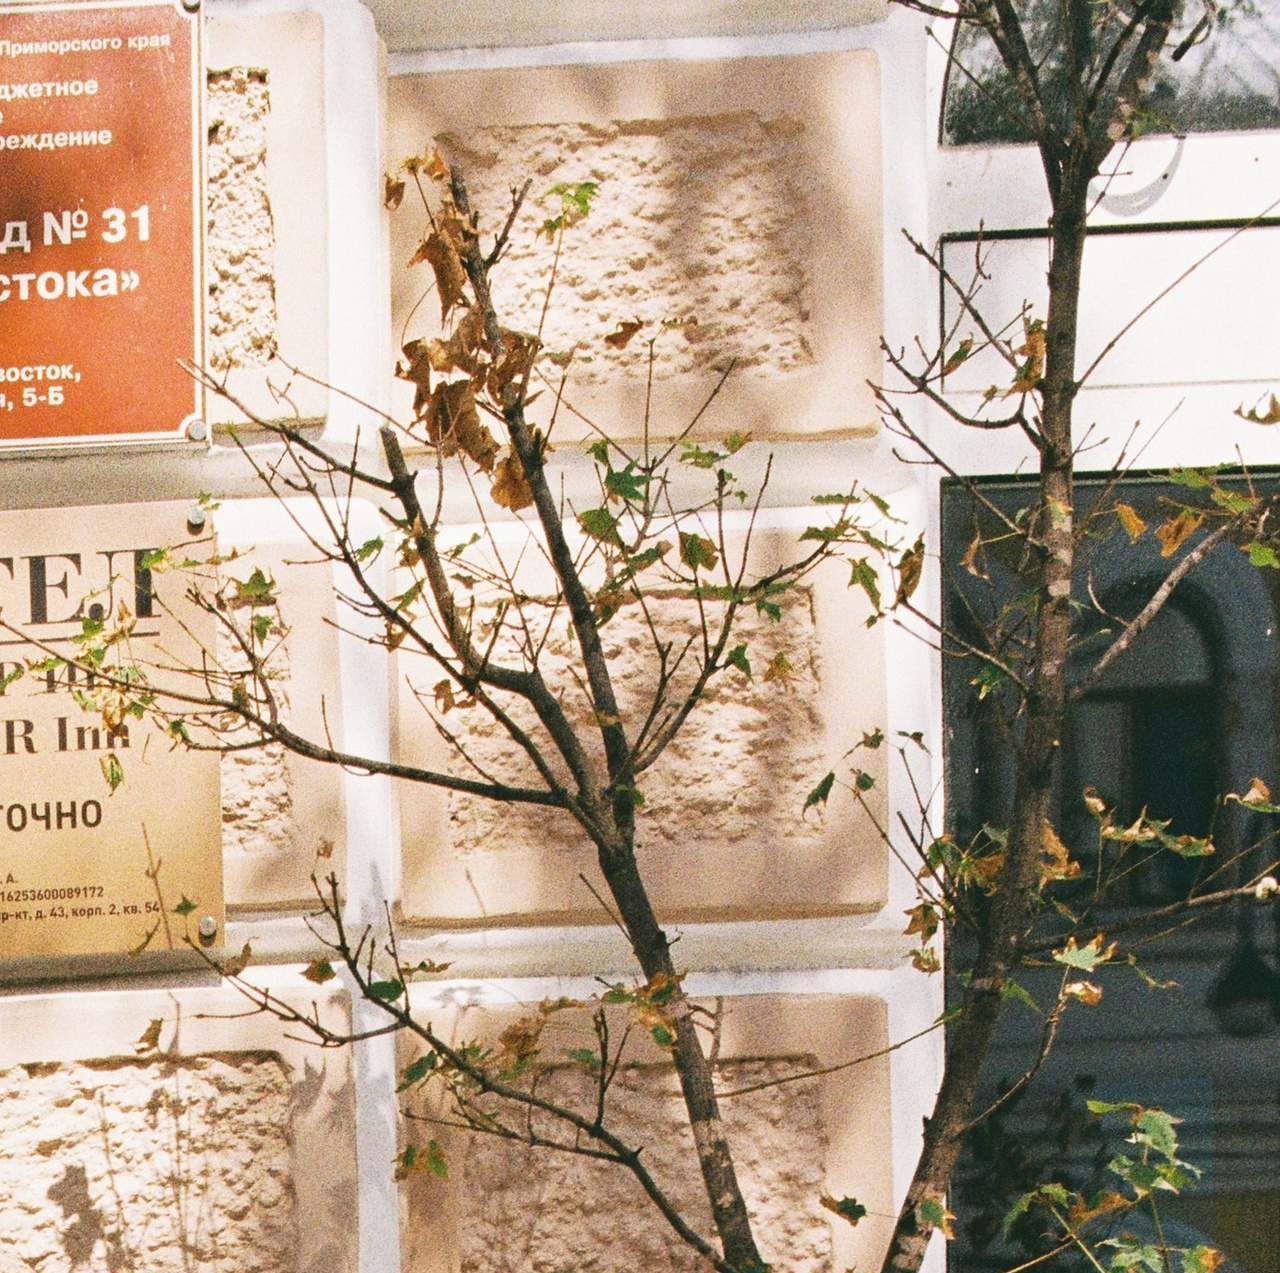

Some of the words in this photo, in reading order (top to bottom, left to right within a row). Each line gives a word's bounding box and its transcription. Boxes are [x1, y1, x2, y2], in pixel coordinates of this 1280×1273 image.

[127, 33, 170, 50] края
[43, 209, 89, 246] №
[101, 205, 150, 243] 31
[22, 386, 65, 407] 5-Б
[53, 716, 132, 753] Inn
[6, 872, 18, 885] А.
[35, 908, 47, 921] д.
[50, 905, 69, 920] 43,
[72, 905, 107, 918] корп.
[109, 903, 121, 916] 2,
[123, 904, 143, 916] кв.
[145, 900, 161, 914] 54
